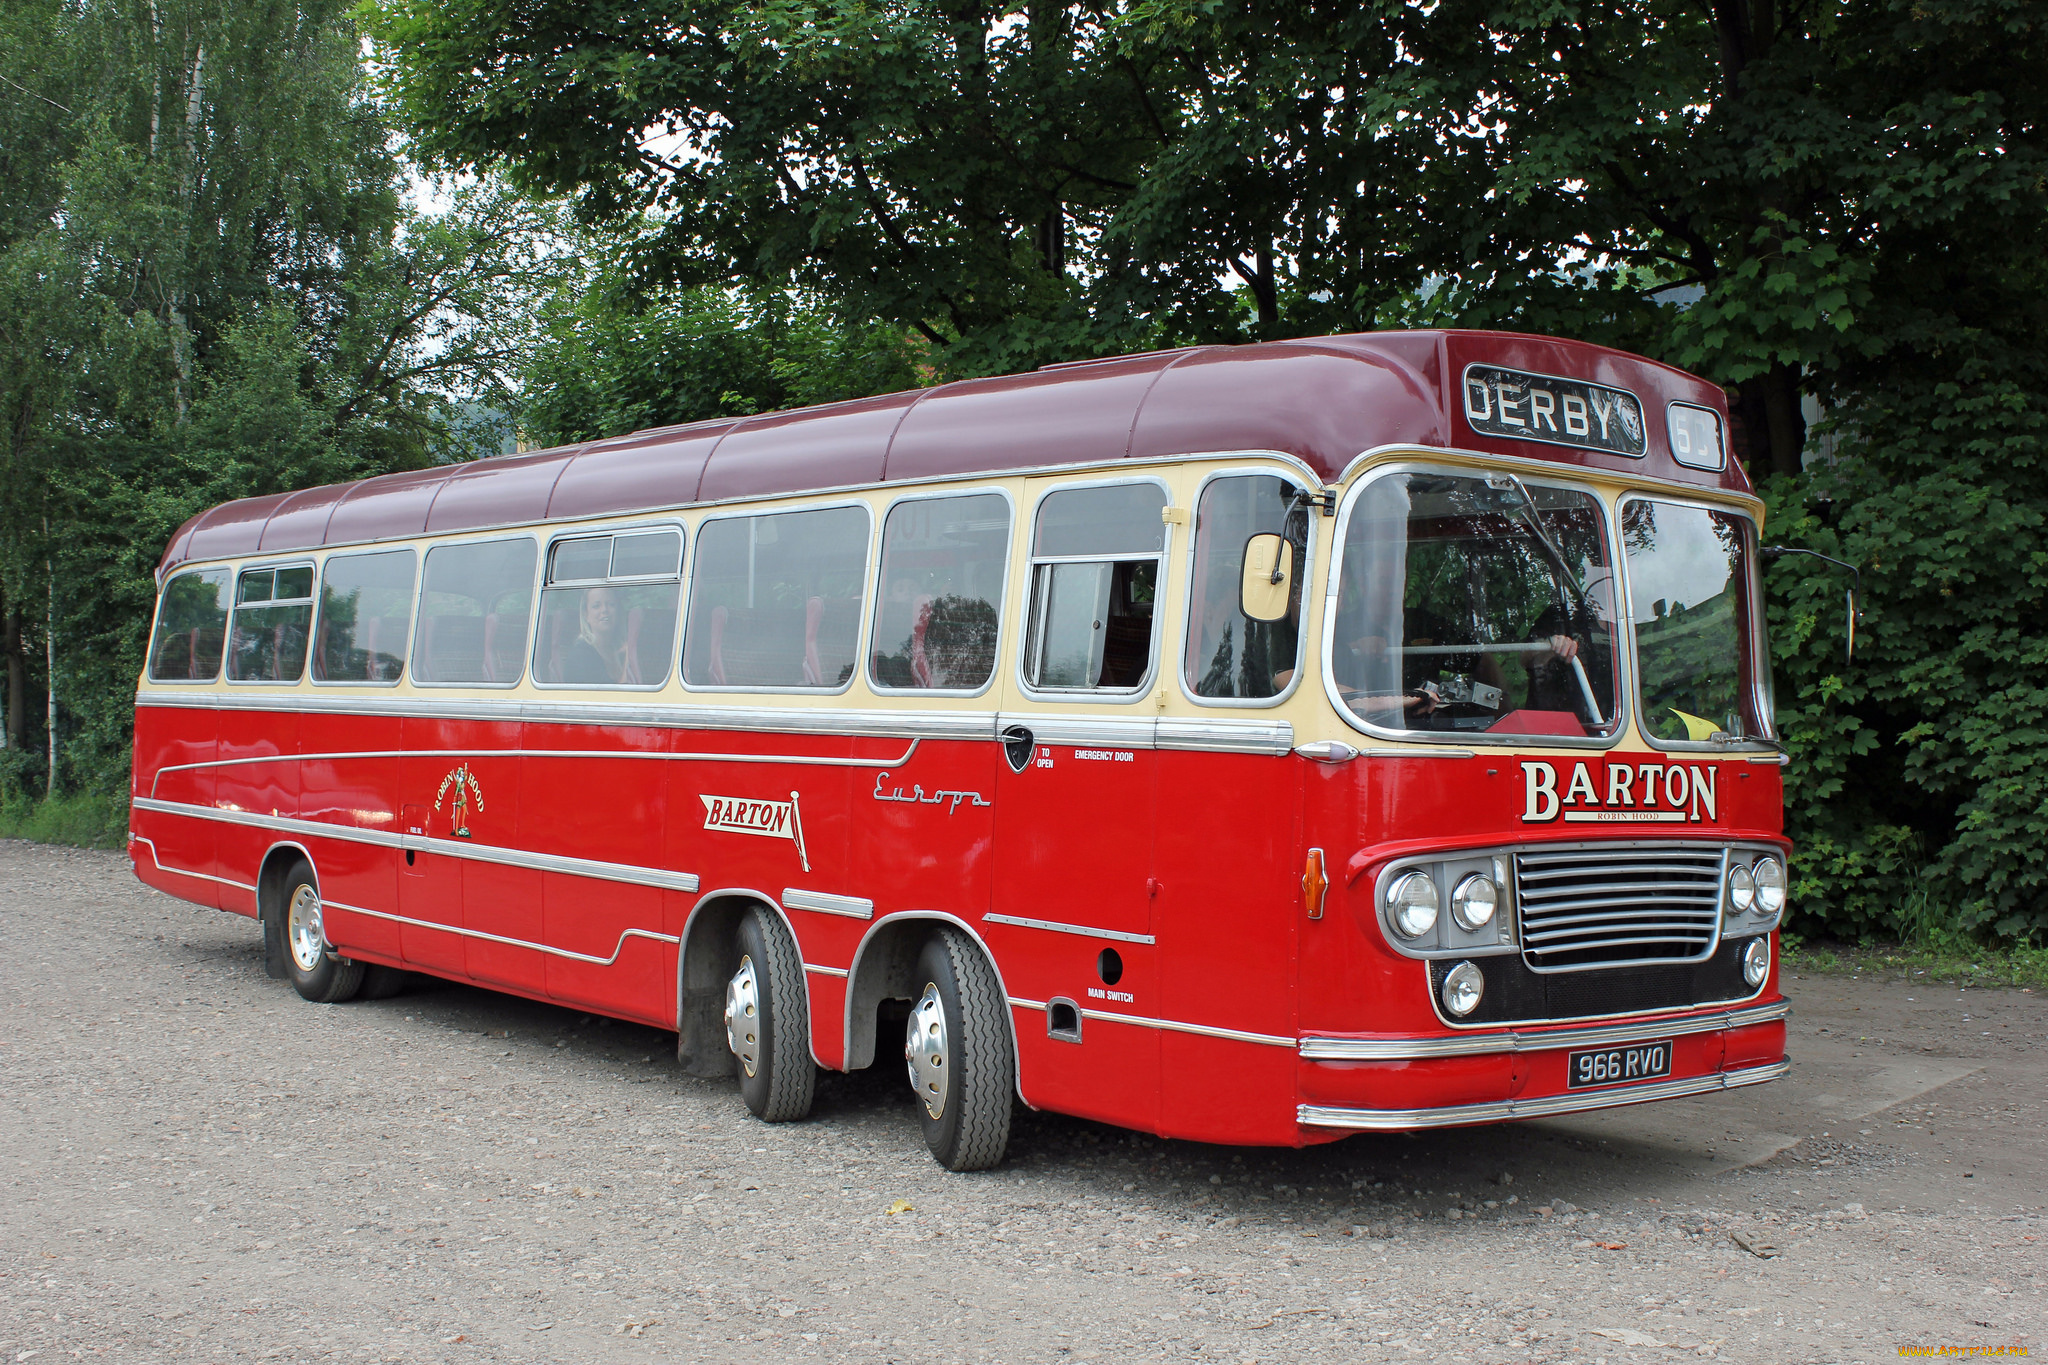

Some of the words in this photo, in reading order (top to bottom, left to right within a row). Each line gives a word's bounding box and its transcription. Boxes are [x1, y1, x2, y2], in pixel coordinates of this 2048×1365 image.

[1466, 377, 1614, 440] DERBY
[1036, 758, 1054, 768] OPEN
[1041, 747, 1050, 757] TO
[1074, 749, 1114, 761] EMERGENCY
[1114, 751, 1134, 762] DOOR
[434, 769, 455, 812] ROBIN
[467, 772, 485, 813] HOOD
[873, 771, 992, 815] Europa
[1520, 761, 1718, 823] BARTON
[707, 799, 789, 832] BARTON
[1597, 812, 1628, 820] ROBIN
[1632, 812, 1659, 820] HOOD
[1087, 987, 1106, 1000] MAIN
[1106, 990, 1134, 1003] SWITCH
[1578, 1052, 1621, 1082] 966
[1625, 1046, 1665, 1077] RVO
